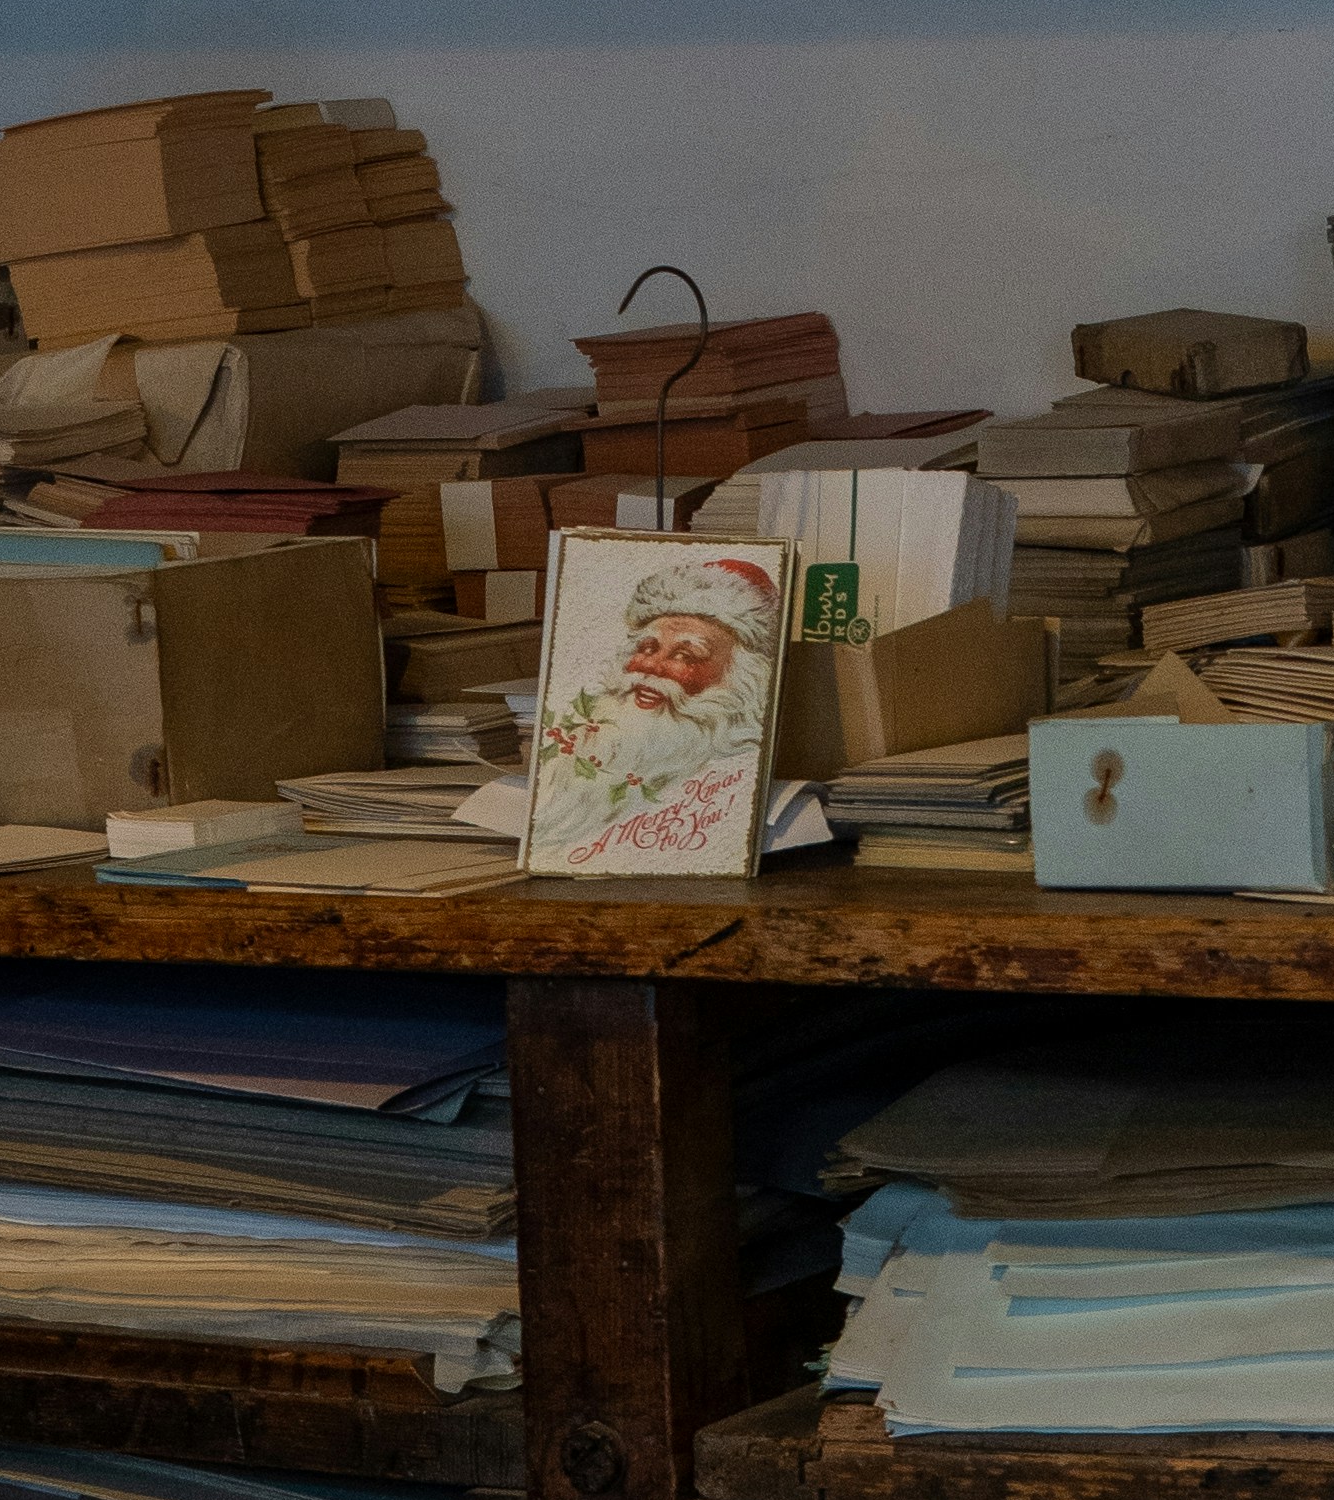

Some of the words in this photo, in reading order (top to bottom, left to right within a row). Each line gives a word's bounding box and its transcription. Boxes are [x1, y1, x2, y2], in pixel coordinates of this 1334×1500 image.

[616, 798, 691, 849] Merry
[684, 769, 745, 804] Xmas
[657, 816, 684, 851] to
[677, 794, 736, 851] You!
